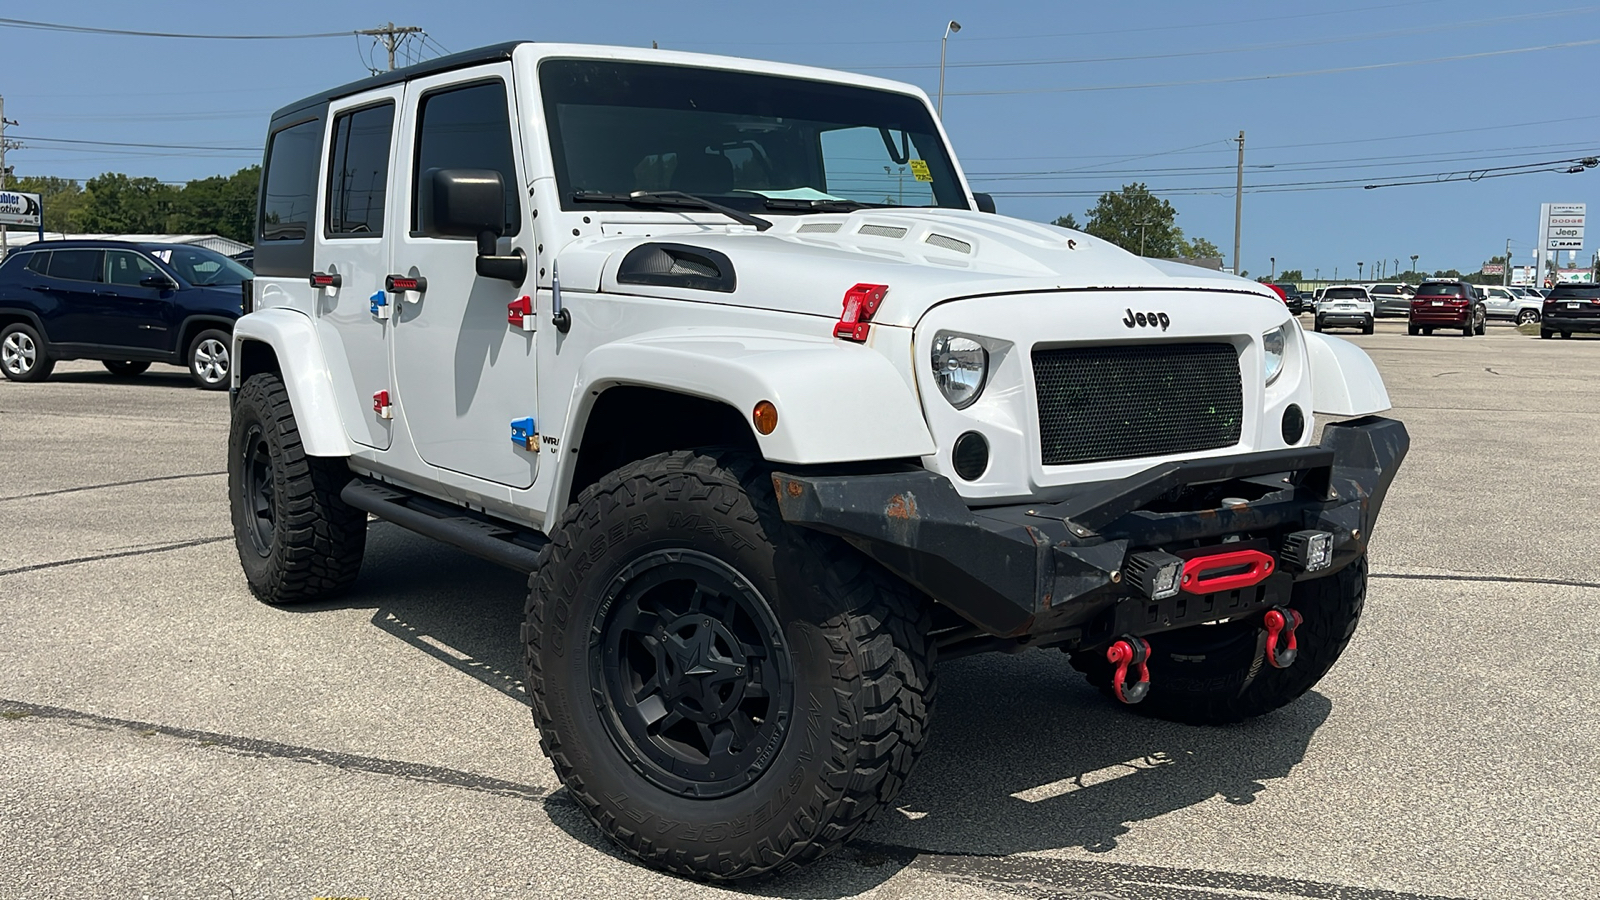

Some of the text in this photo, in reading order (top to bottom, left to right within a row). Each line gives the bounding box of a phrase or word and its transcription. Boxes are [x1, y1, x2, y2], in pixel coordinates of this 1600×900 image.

[1555, 228, 1578, 237] Jeep
[1122, 308, 1170, 332] Jeep
[550, 512, 649, 659] COURSER
[667, 511, 758, 552] MXT
[603, 692, 823, 844] MASTERCRAFT
